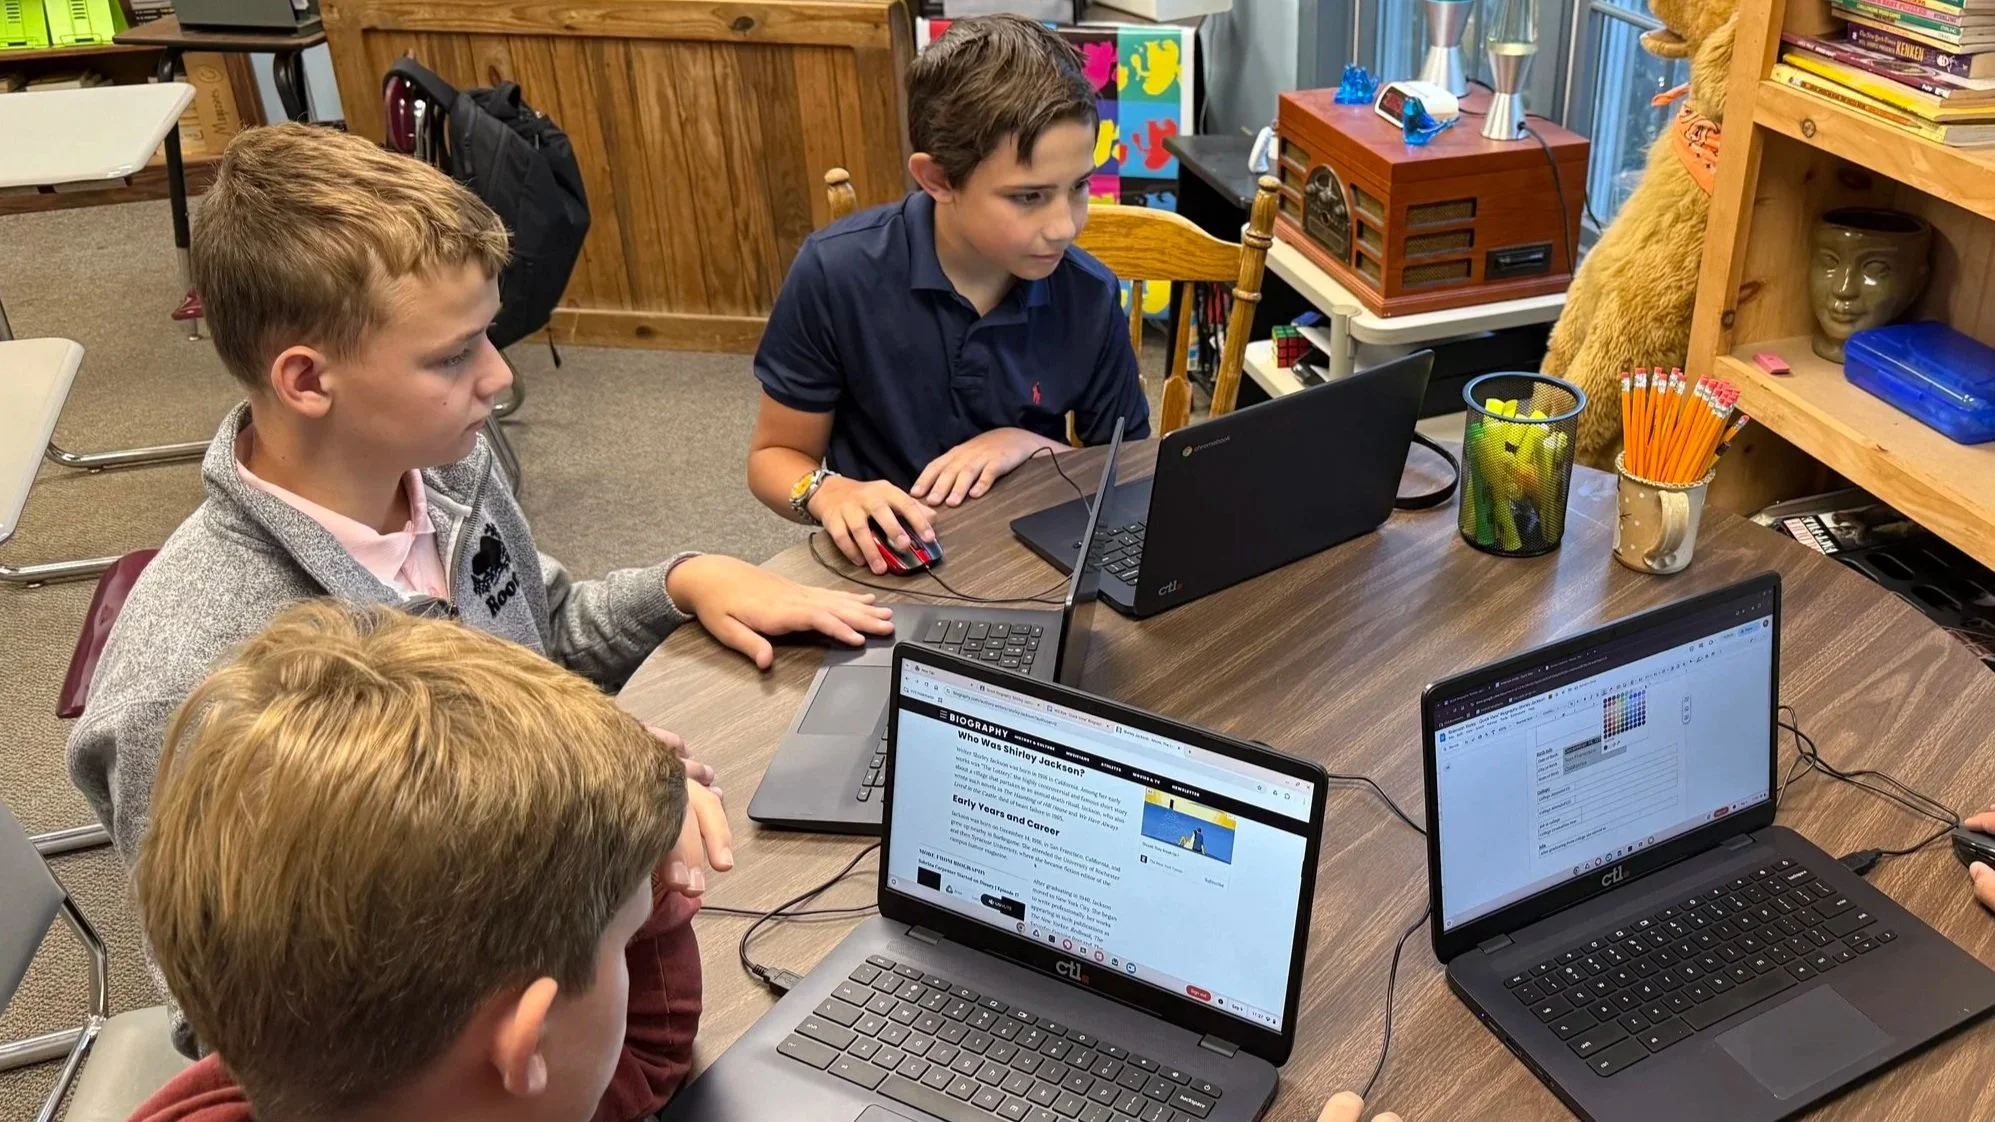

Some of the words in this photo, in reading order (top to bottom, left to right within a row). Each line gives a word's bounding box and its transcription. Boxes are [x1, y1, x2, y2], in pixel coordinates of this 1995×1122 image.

[949, 713, 1009, 738] BIOGRAPHY
[957, 730, 979, 744] Who
[980, 737, 1001, 751] Was
[1003, 744, 1037, 764] Shirley
[1038, 756, 1085, 777] Jackson?
[1171, 784, 1200, 797] NEWSLETTER
[952, 794, 976, 811] Early
[978, 802, 1005, 818] Years
[1006, 813, 1025, 825] and
[1026, 819, 1060, 836] Career
